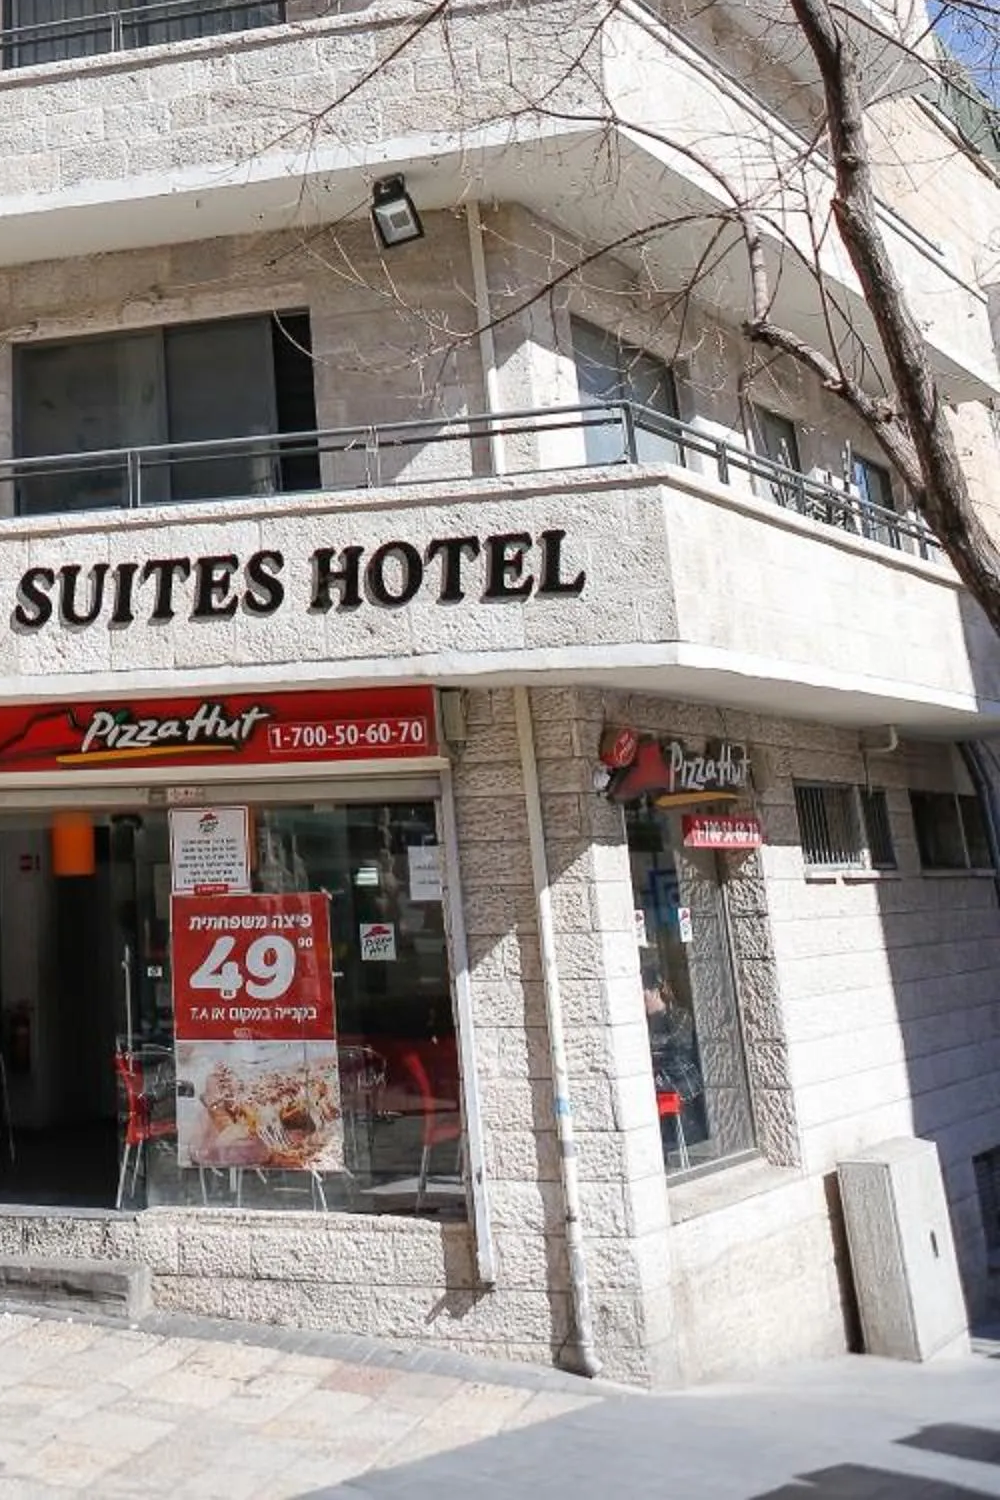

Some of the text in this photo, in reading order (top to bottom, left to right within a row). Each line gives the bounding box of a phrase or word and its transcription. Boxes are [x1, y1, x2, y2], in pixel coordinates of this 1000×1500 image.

[11, 549, 285, 632] SUITES
[306, 529, 587, 613] HOTEL
[81, 704, 270, 752] Pizza Hut
[270, 720, 424, 749] 1-700-50-60-70
[668, 741, 717, 792] Pizza
[717, 743, 752, 788] Hut
[188, 913, 313, 931] פיצה משפחתית
[297, 937, 313, 949] 90
[189, 935, 296, 1000] 49
[211, 1008, 226, 1021] או
[229, 1007, 271, 1023] במקום
